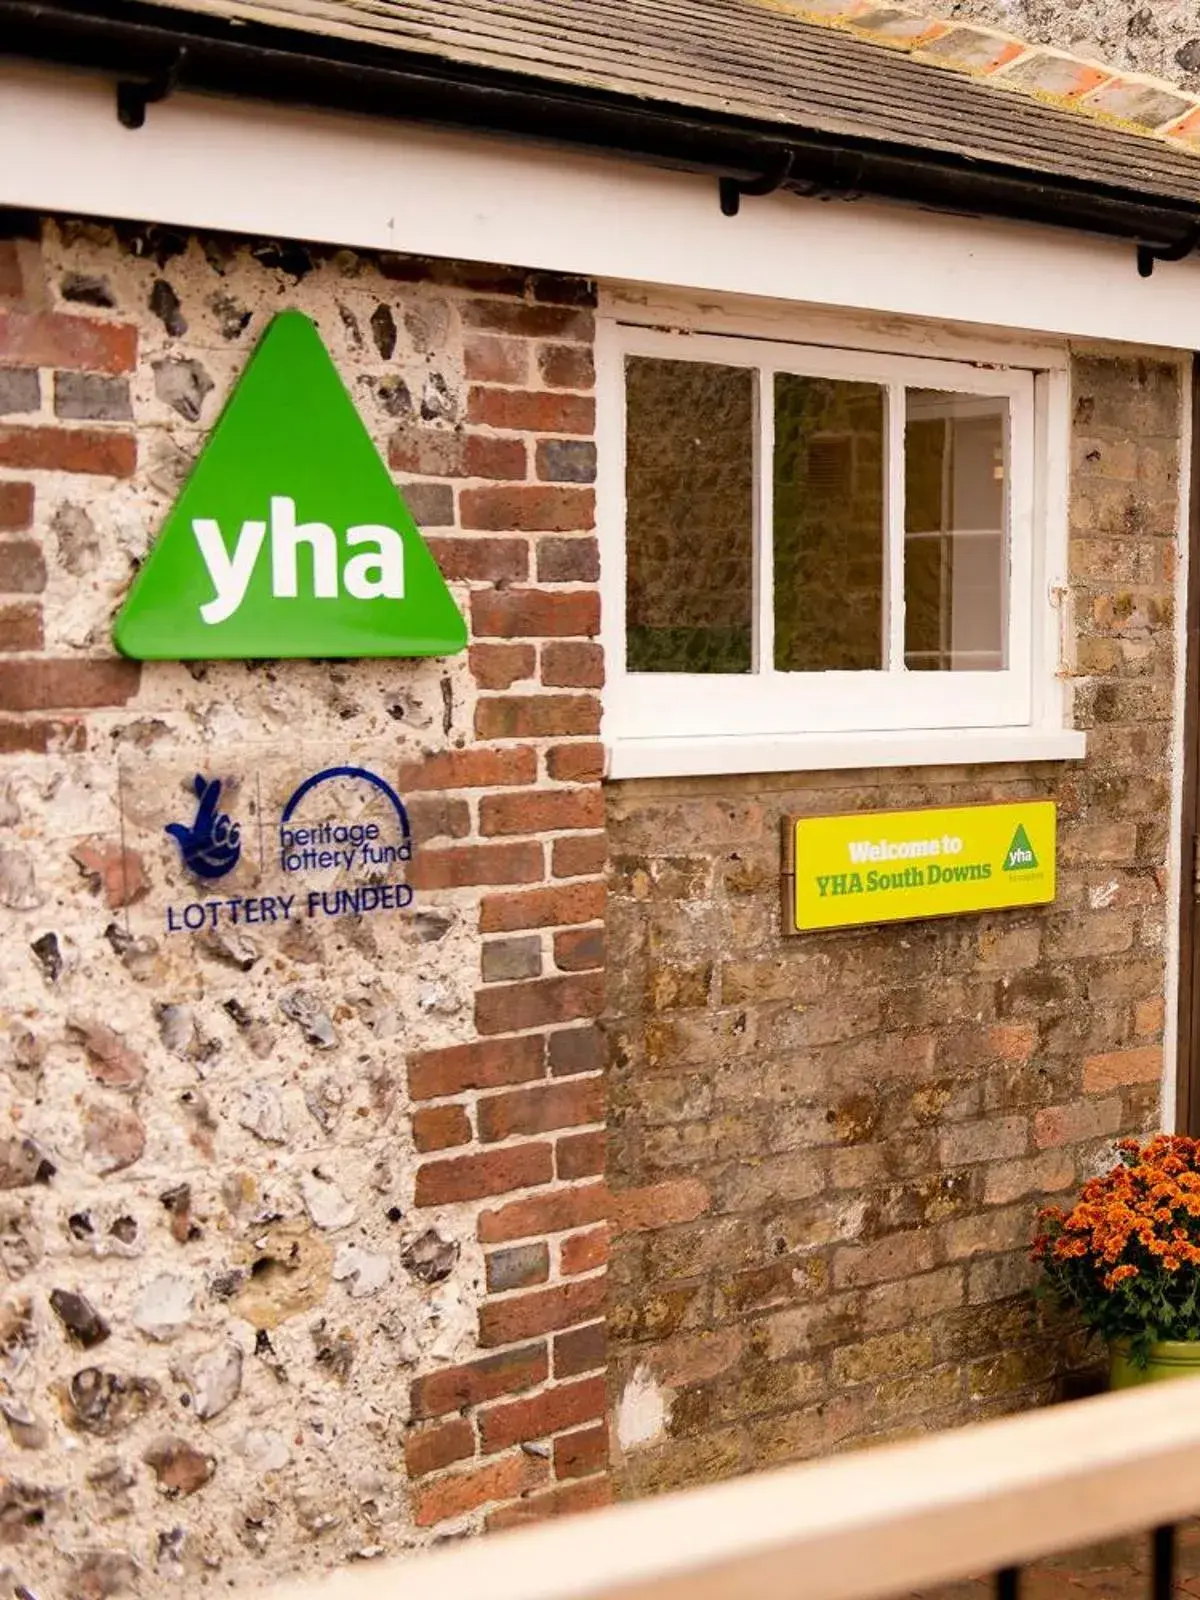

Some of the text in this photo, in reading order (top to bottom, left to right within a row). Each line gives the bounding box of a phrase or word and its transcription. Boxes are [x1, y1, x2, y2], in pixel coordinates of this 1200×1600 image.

[191, 495, 405, 625] yha
[280, 823, 379, 848] heritage
[849, 834, 963, 864] Welcome to
[280, 841, 413, 872] lottery fund
[1008, 848, 1033, 867] yha
[816, 872, 864, 897] YHA
[867, 867, 924, 892] South
[927, 862, 992, 885] Downs
[167, 884, 413, 931] LOTTERY FUNDED
